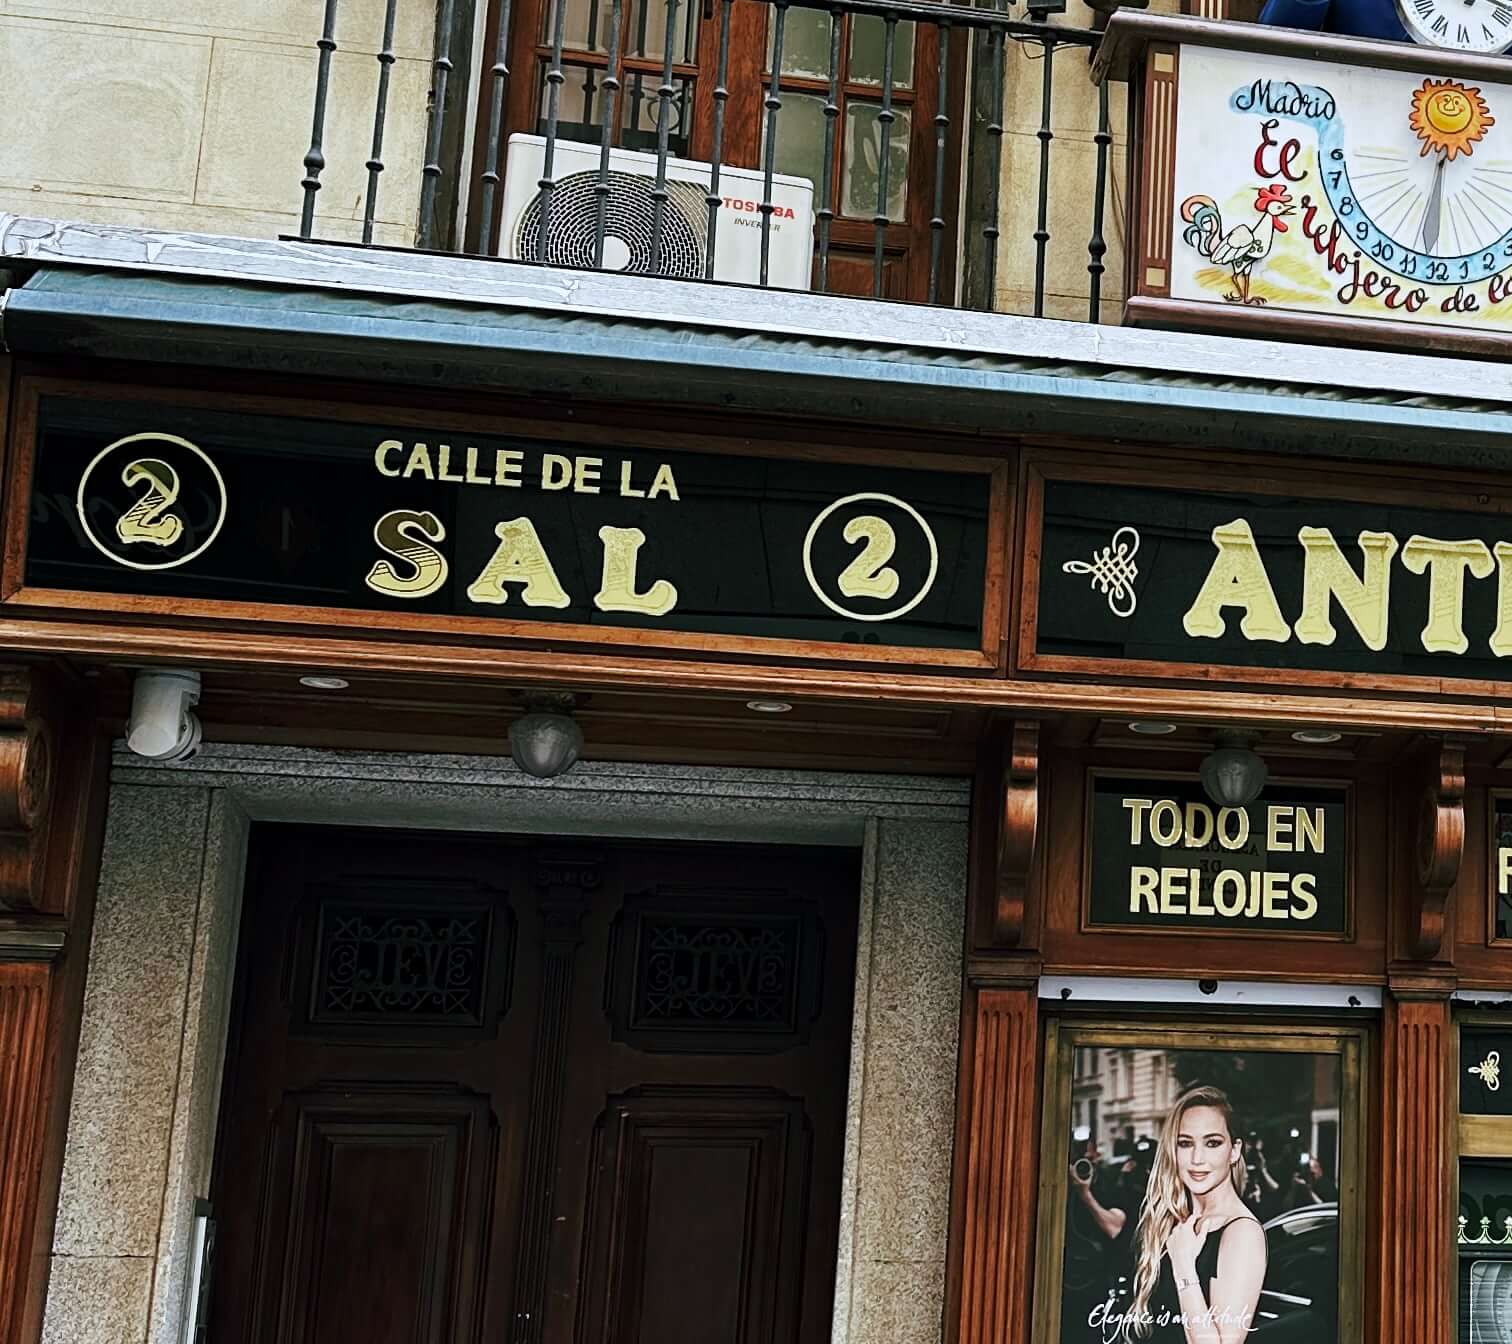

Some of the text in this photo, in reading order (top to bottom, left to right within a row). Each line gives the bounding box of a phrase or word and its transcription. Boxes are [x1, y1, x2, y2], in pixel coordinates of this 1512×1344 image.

[1236, 78, 1336, 120] Madrid
[1254, 119, 1308, 182] El
[1331, 149, 1344, 161] 6
[1328, 171, 1342, 190] 7
[723, 197, 795, 220] TOSBA
[1339, 197, 1353, 216] 8
[1357, 222, 1369, 240] 9
[1372, 241, 1394, 260] 10
[1483, 253, 1495, 271] 2
[1400, 259, 1417, 275] 11
[1425, 261, 1449, 281] 12
[1460, 261, 1469, 279] 1
[1441, 286, 1480, 312] de
[375, 439, 680, 502] CALLE DE LA
[115, 457, 184, 547] 2
[364, 509, 679, 618] SAL
[837, 515, 900, 600] 2
[1123, 796, 1325, 855] TODO EN
[1128, 869, 1319, 923] RELOJES
